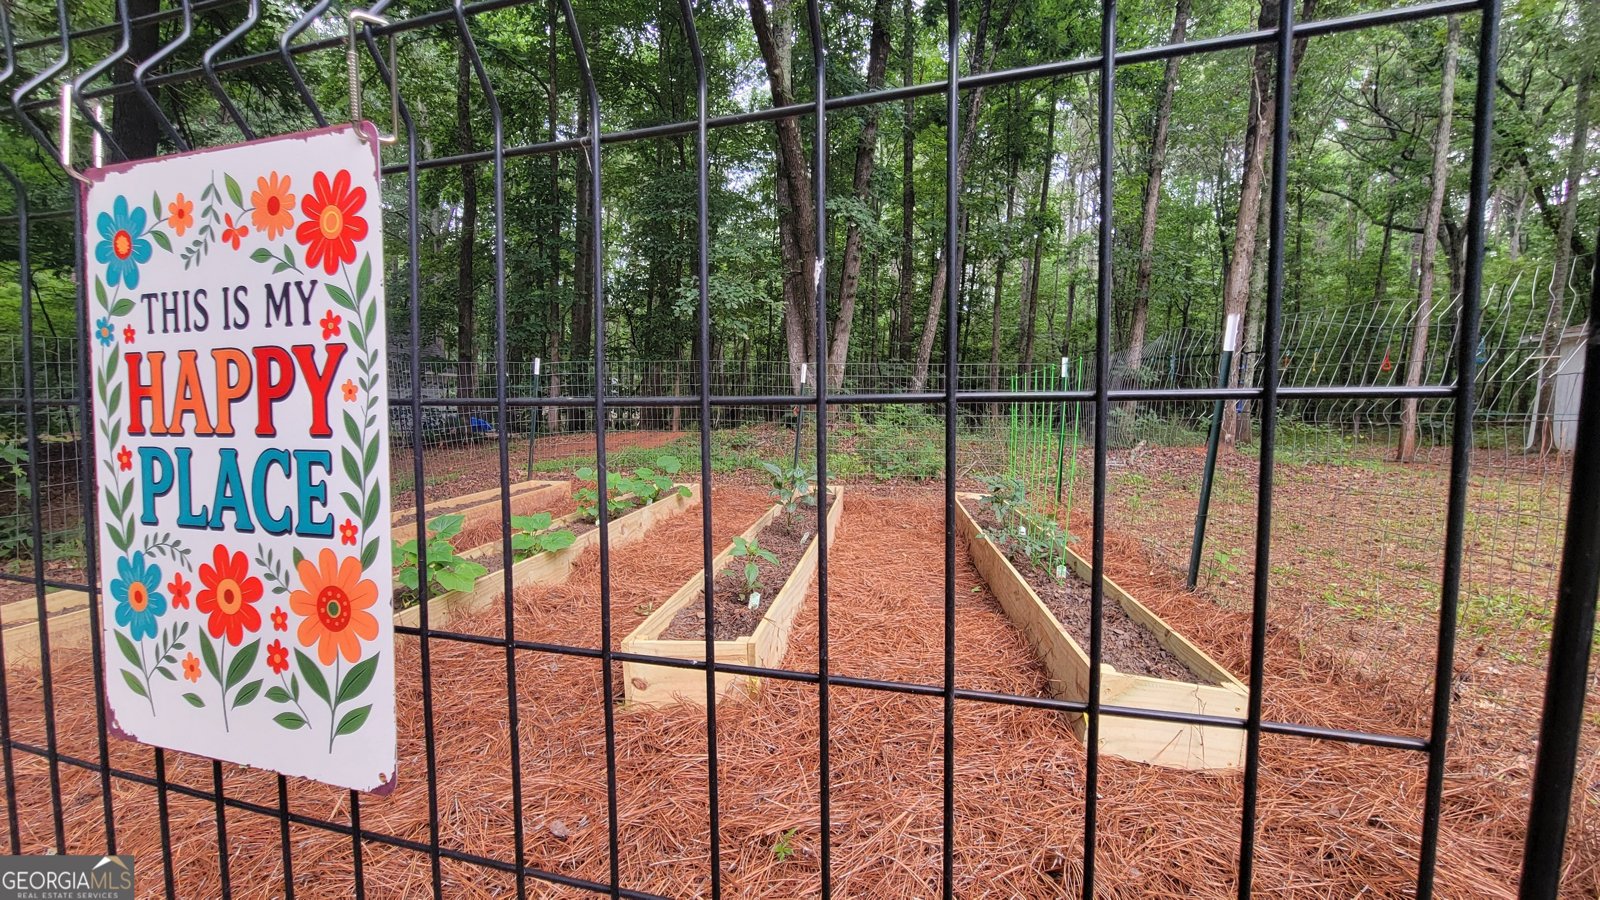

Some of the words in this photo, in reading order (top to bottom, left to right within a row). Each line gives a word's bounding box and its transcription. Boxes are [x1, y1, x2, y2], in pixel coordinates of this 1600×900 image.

[141, 288, 209, 334] THIS
[222, 285, 251, 330] IS
[264, 279, 318, 328] MY
[124, 342, 348, 439] HAPPY
[137, 446, 335, 538] PLACE
